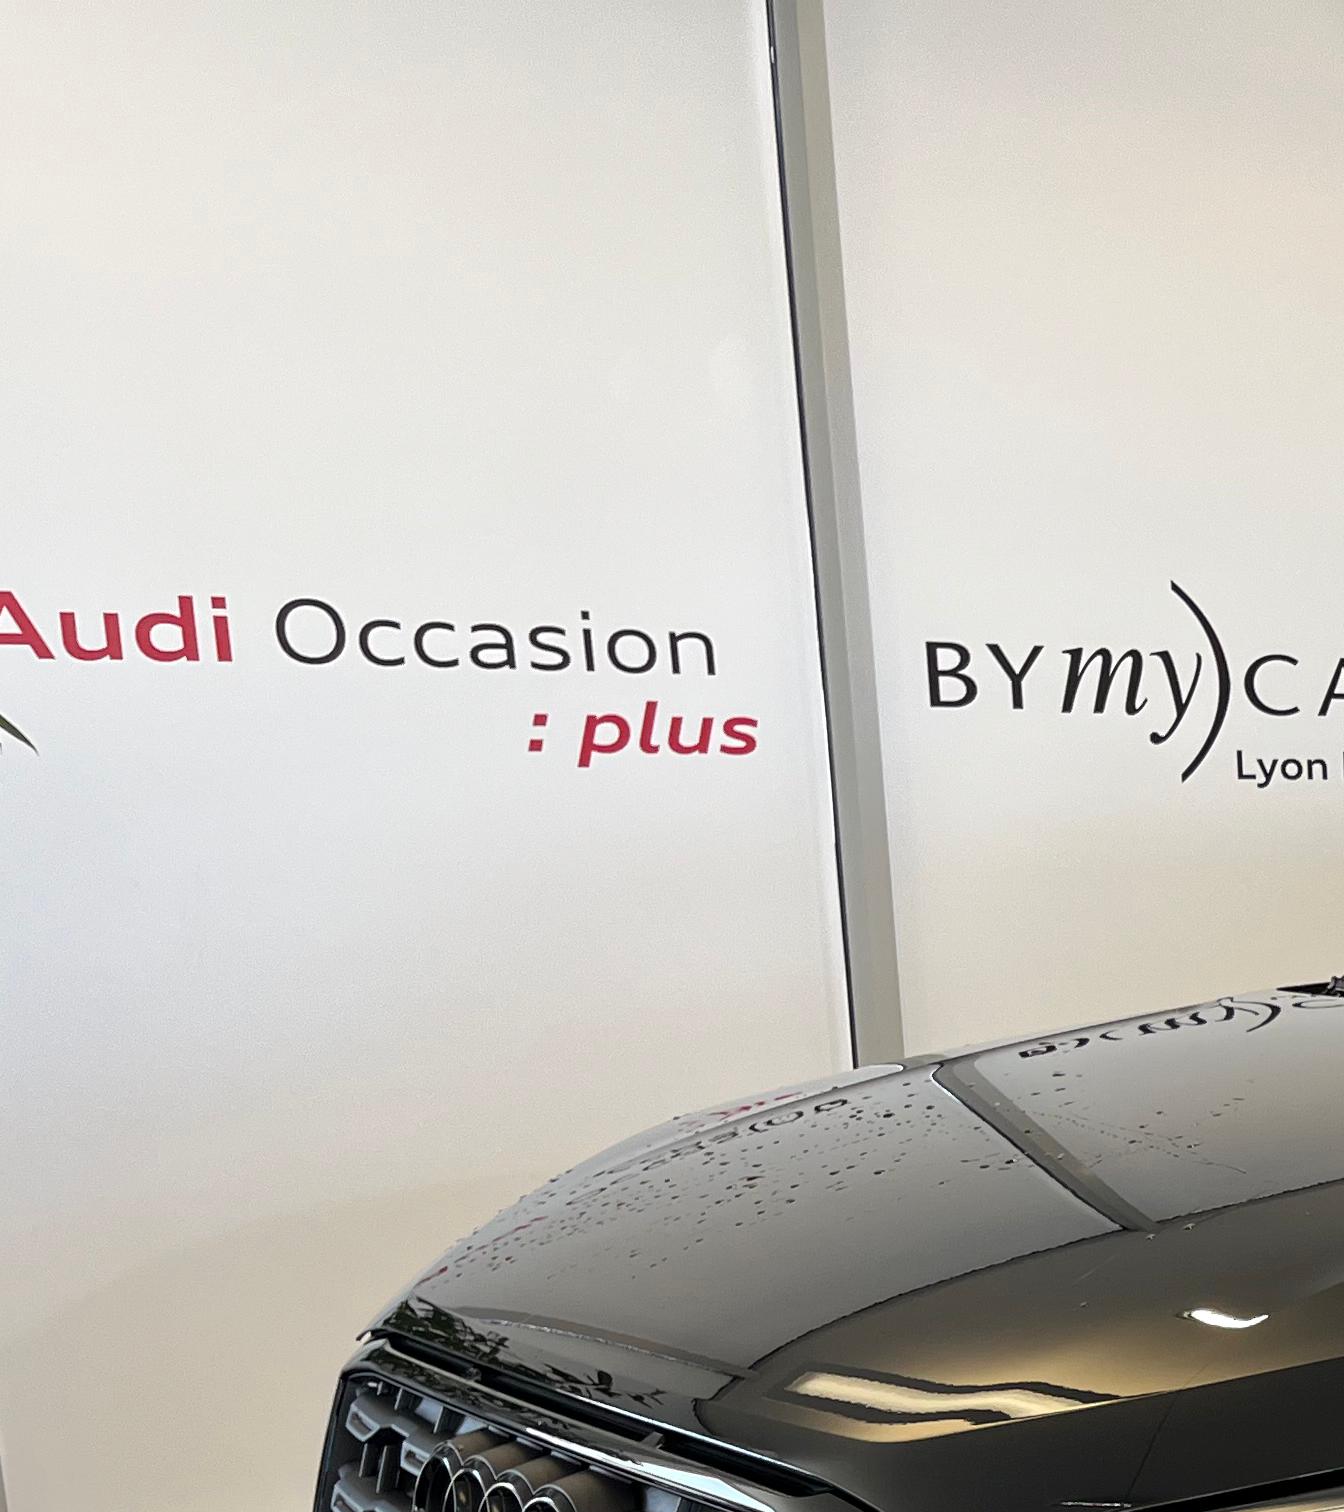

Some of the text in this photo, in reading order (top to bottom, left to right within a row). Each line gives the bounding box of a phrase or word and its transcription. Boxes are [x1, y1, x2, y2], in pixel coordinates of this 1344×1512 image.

[0, 590, 717, 676] Audi Occasion
[1236, 749, 1328, 789] Lyon
